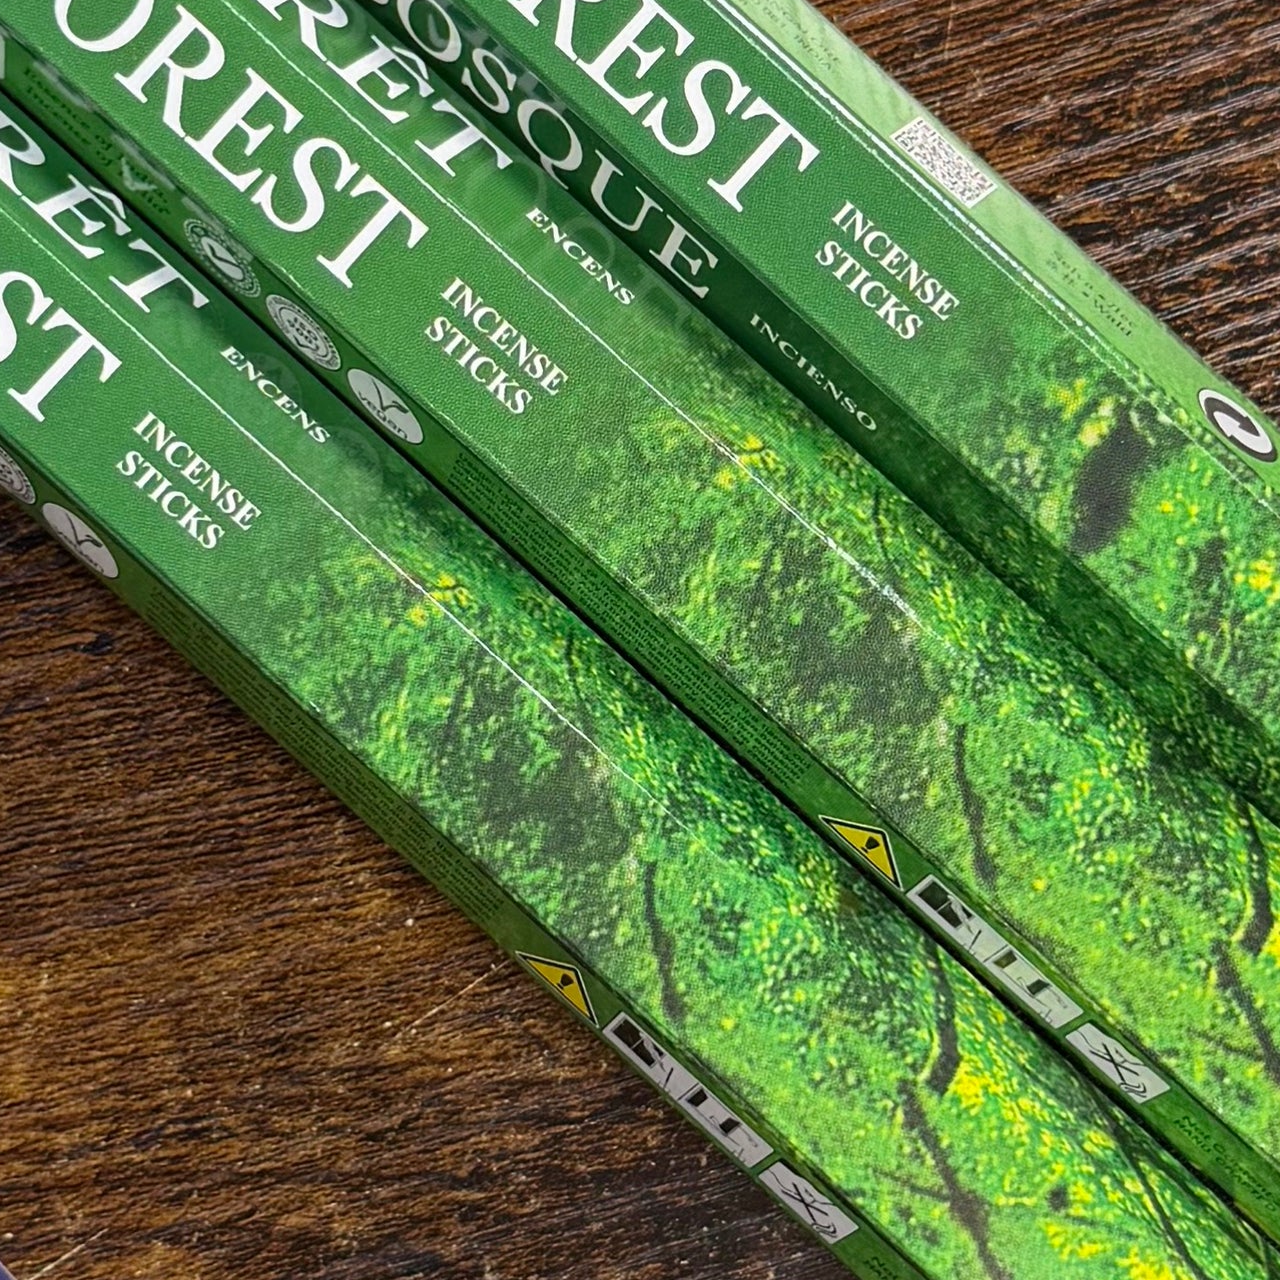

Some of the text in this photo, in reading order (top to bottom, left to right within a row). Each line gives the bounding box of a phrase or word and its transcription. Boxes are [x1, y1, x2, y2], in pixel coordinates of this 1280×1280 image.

[524, 205, 636, 306] ENCENS
[814, 240, 924, 341] STICKS
[831, 201, 961, 321] INCENSE
[424, 315, 534, 415] STICKS
[440, 276, 570, 396] INCENSE
[749, 313, 877, 432] INCIENSO
[220, 345, 332, 444] ENCENS
[115, 450, 226, 550] STICKS
[132, 411, 262, 532] INCENSE
